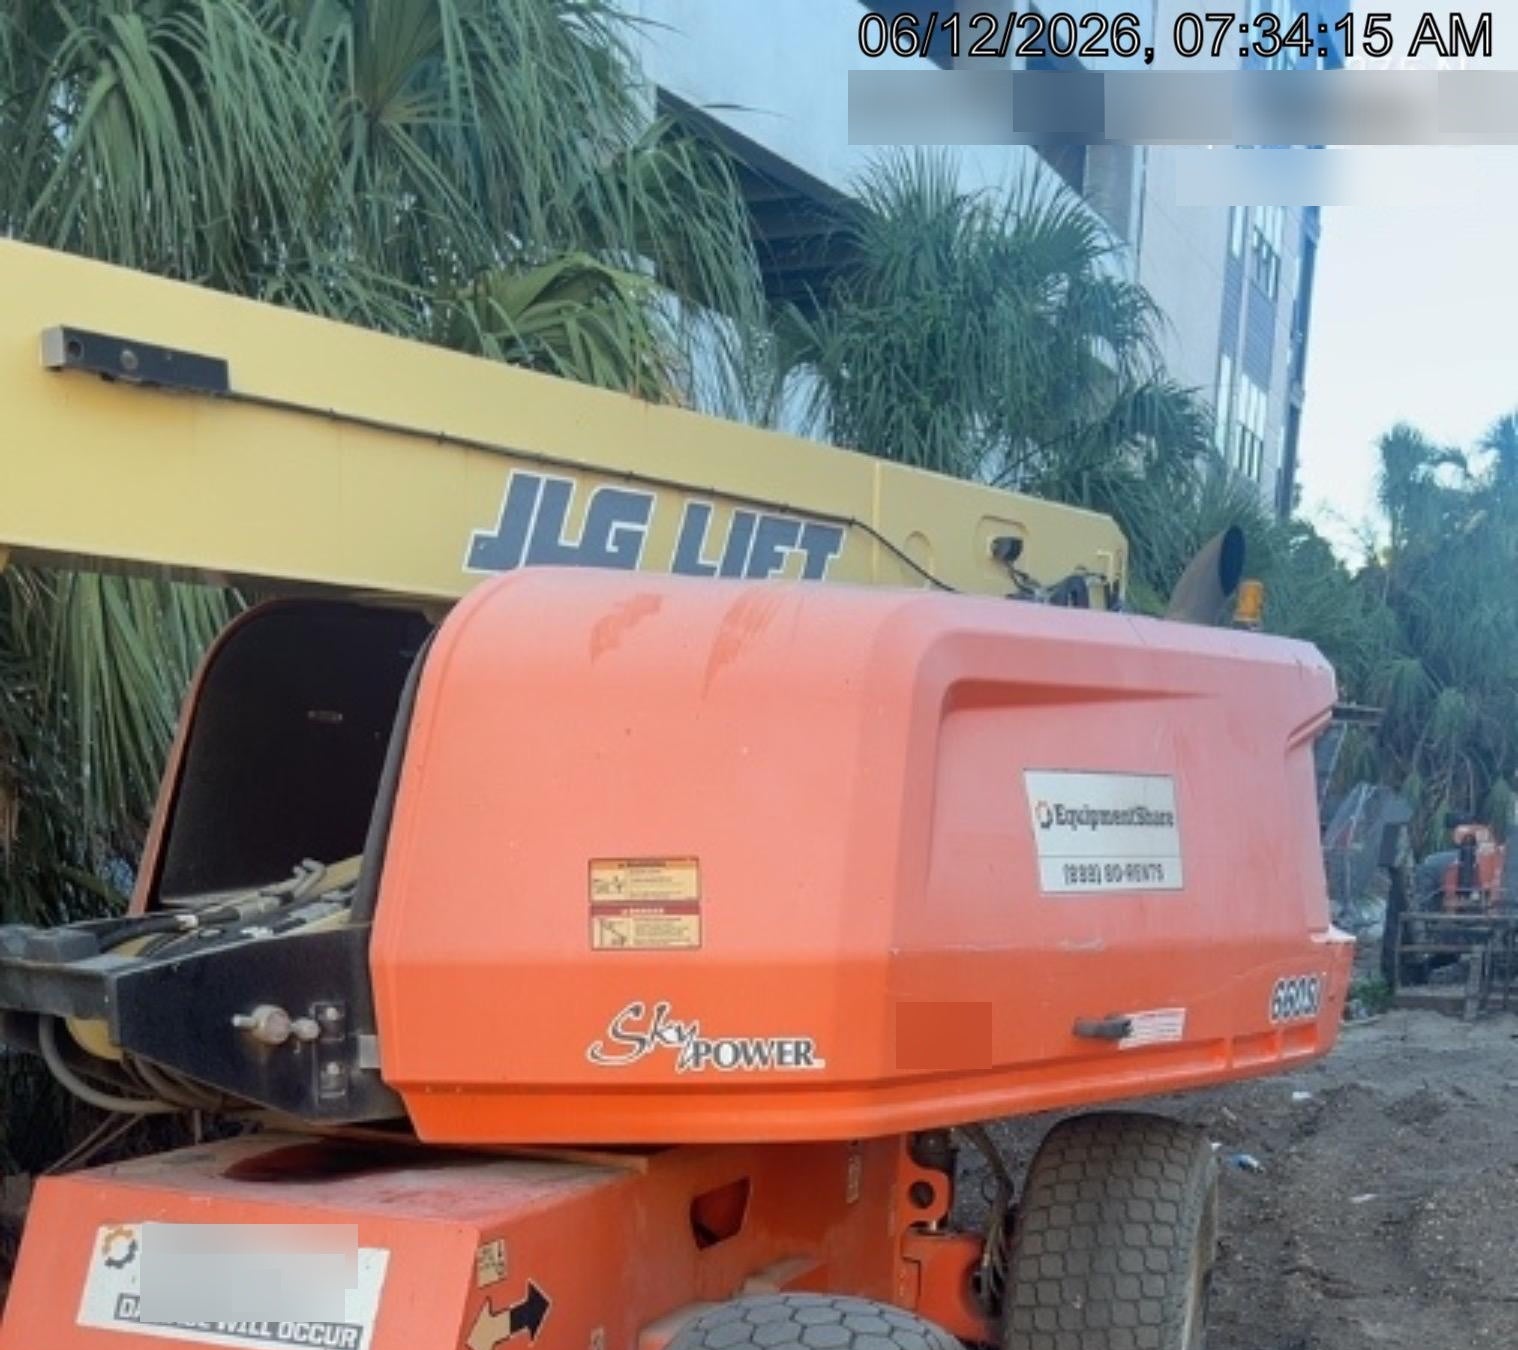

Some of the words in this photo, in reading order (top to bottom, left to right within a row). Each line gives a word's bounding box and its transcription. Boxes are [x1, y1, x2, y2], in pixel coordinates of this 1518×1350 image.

[462, 468, 656, 573] JLG
[669, 499, 846, 581] LIFT
[1053, 803, 1174, 831] EquipmentShare
[278, 1321, 358, 1350] OCCUR
